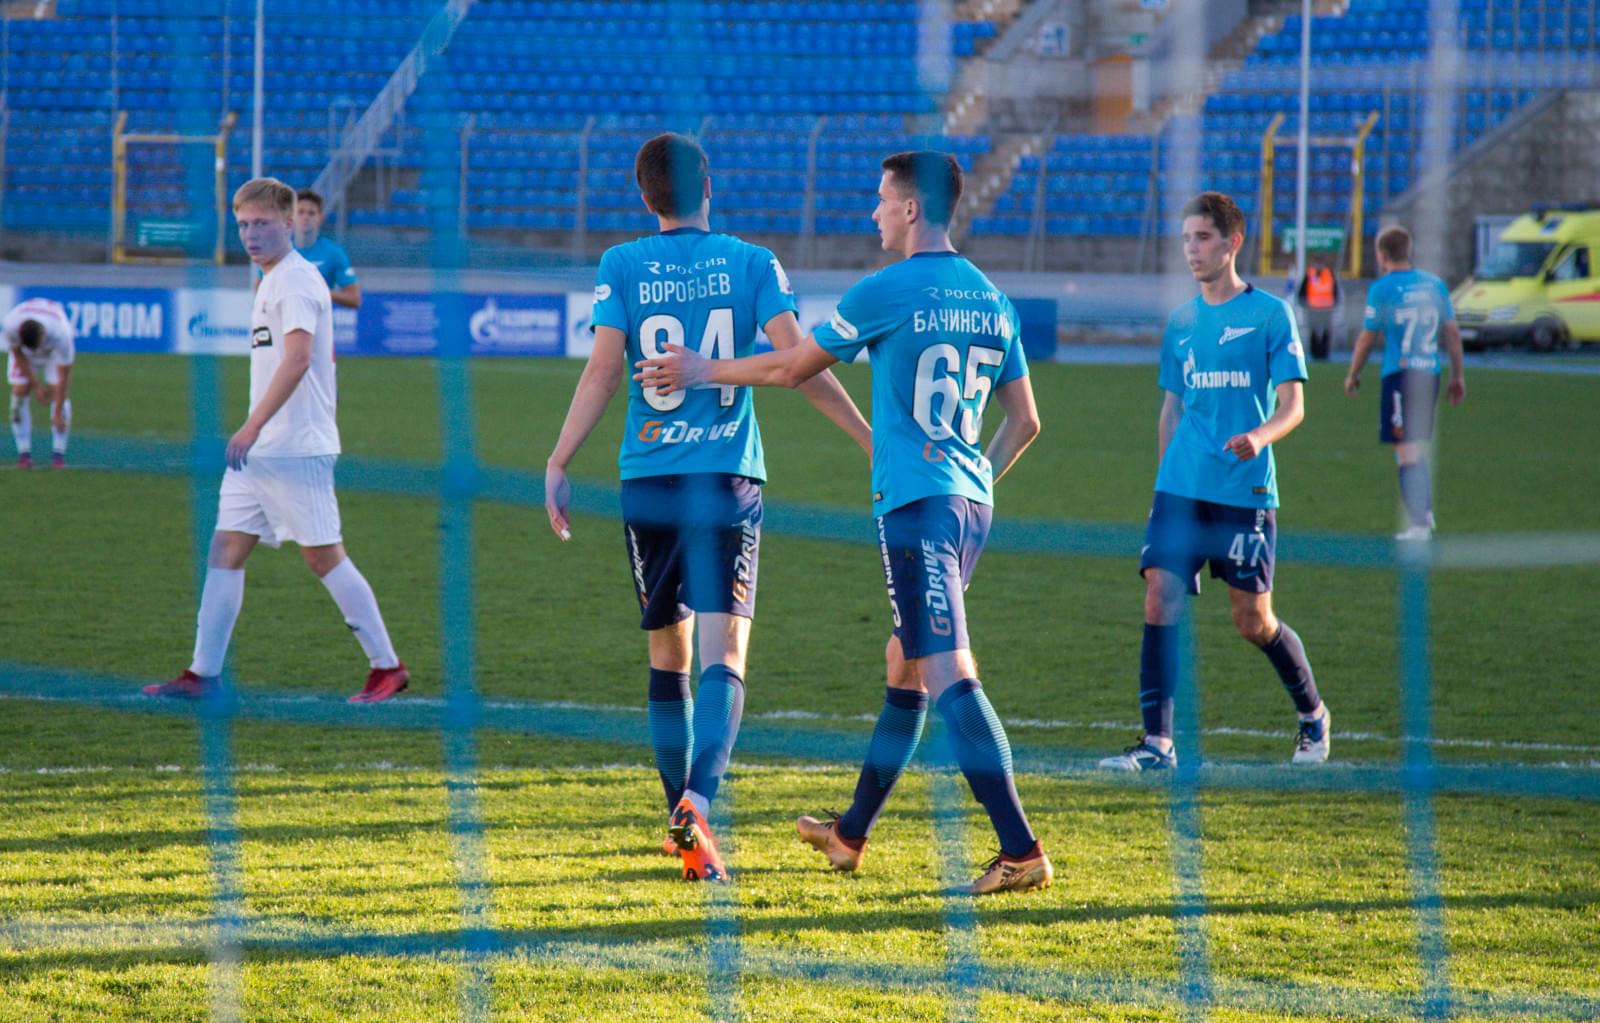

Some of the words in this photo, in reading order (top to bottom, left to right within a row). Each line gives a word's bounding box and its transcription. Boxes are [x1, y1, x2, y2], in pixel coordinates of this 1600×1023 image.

[639, 273, 731, 304] ВОРОБЬЕВ
[68, 302, 163, 338] ZPROM
[1395, 306, 1439, 353] 72
[639, 308, 738, 412] 84
[912, 343, 1005, 445] 65
[1228, 533, 1264, 567] 47
